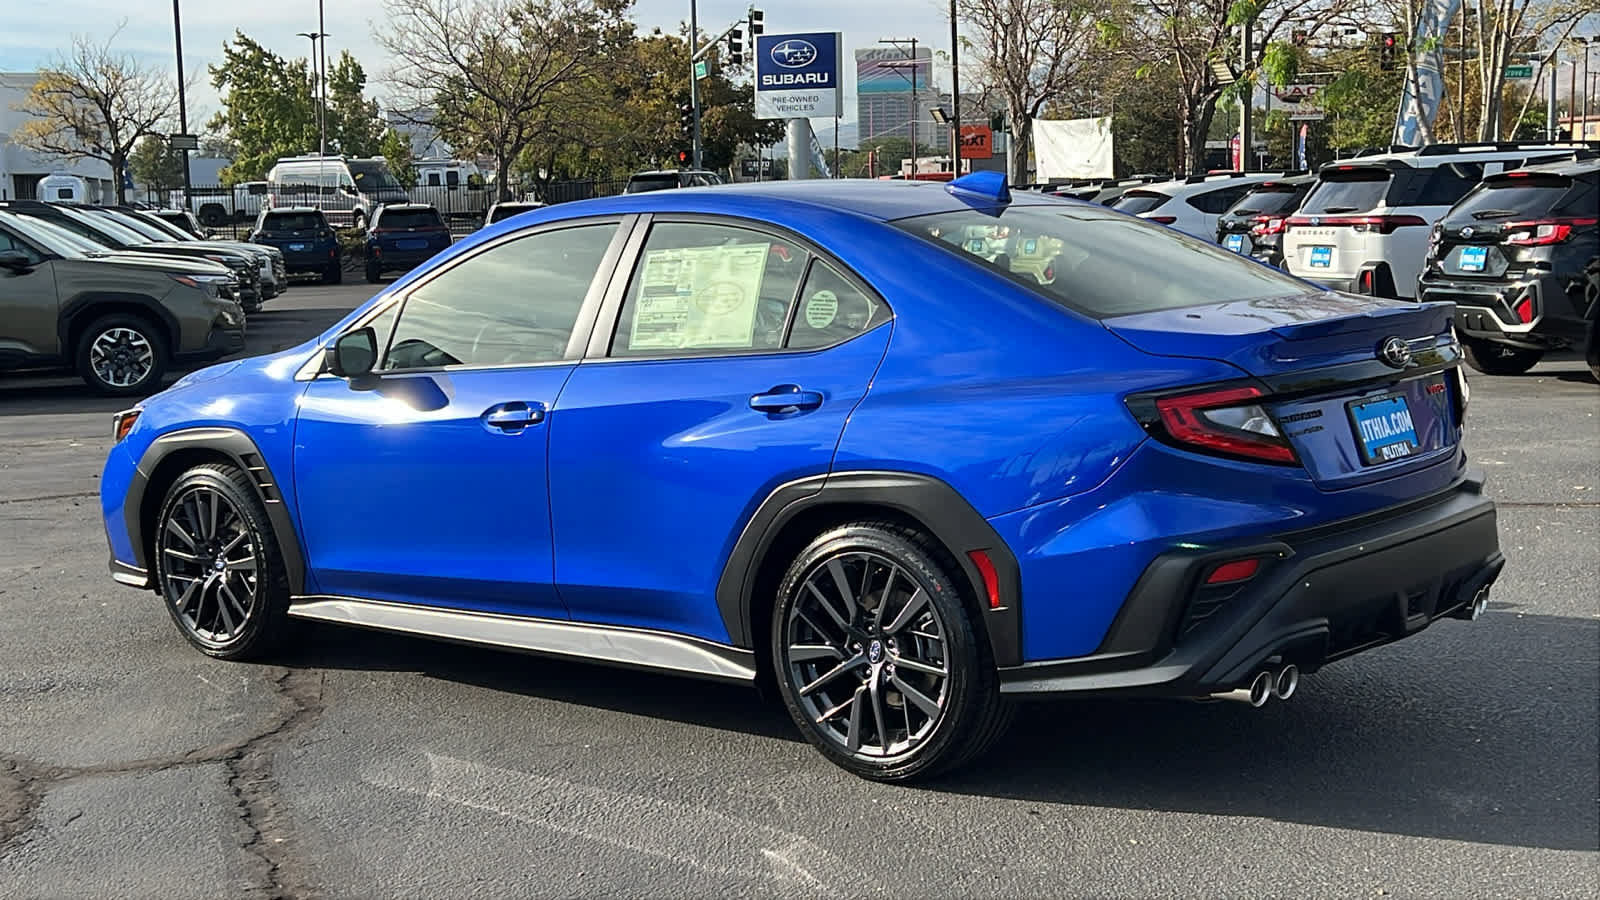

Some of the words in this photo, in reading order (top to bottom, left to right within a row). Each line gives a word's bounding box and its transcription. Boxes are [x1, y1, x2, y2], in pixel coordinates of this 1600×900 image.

[762, 72, 829, 86] SUBARU
[772, 95, 819, 104] PRE-OWNED
[776, 104, 815, 112] VEHICLES
[1361, 410, 1414, 443] ITHIA.COM
